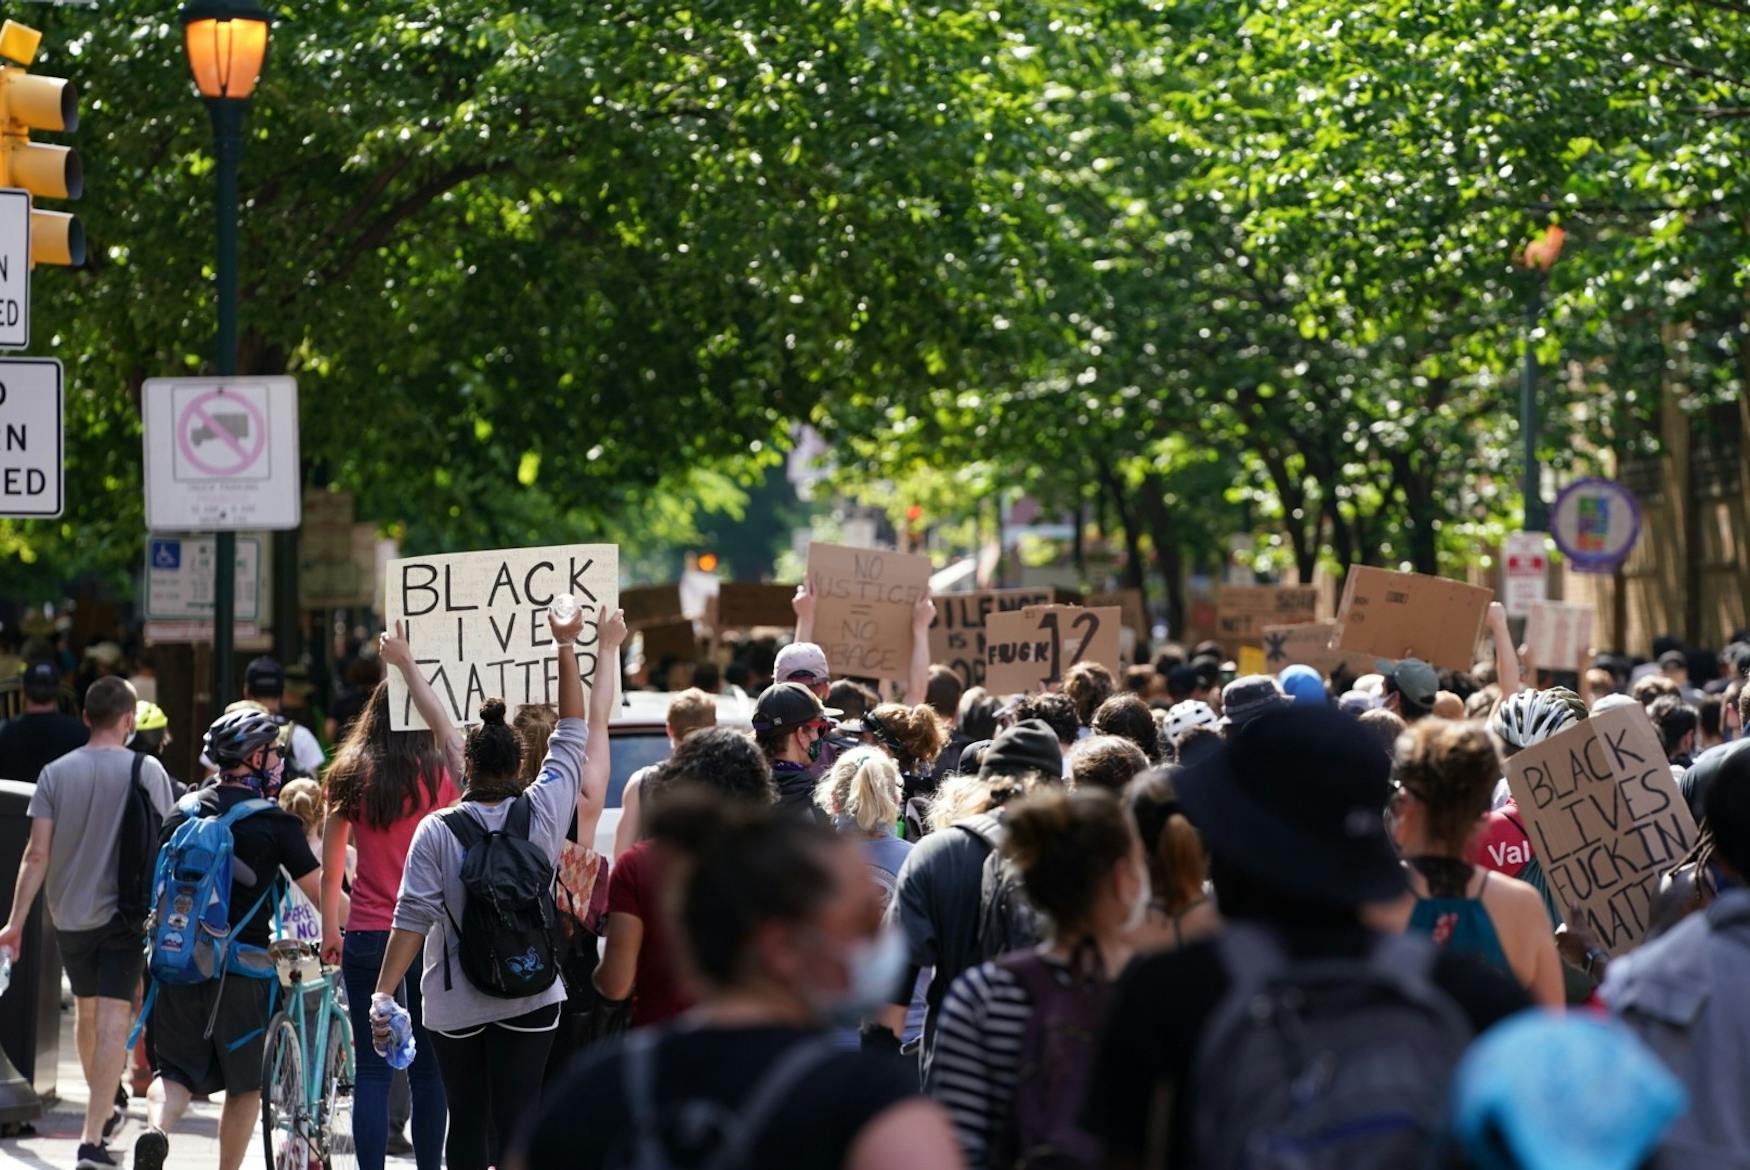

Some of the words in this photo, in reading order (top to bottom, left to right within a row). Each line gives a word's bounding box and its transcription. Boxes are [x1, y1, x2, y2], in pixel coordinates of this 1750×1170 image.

[0, 300, 18, 326] ED
[4, 468, 46, 495] ED
[854, 554, 884, 581] NO
[402, 557, 597, 616] BLACK
[814, 571, 921, 605] USTICE
[841, 620, 880, 641] NO
[1038, 612, 1100, 684] 12
[1523, 728, 1645, 810] BLACK
[1534, 768, 1670, 864] LIVES
[1487, 839, 1531, 867] Val
[1548, 813, 1690, 905] FUCKIN
[297, 920, 319, 939] NO
